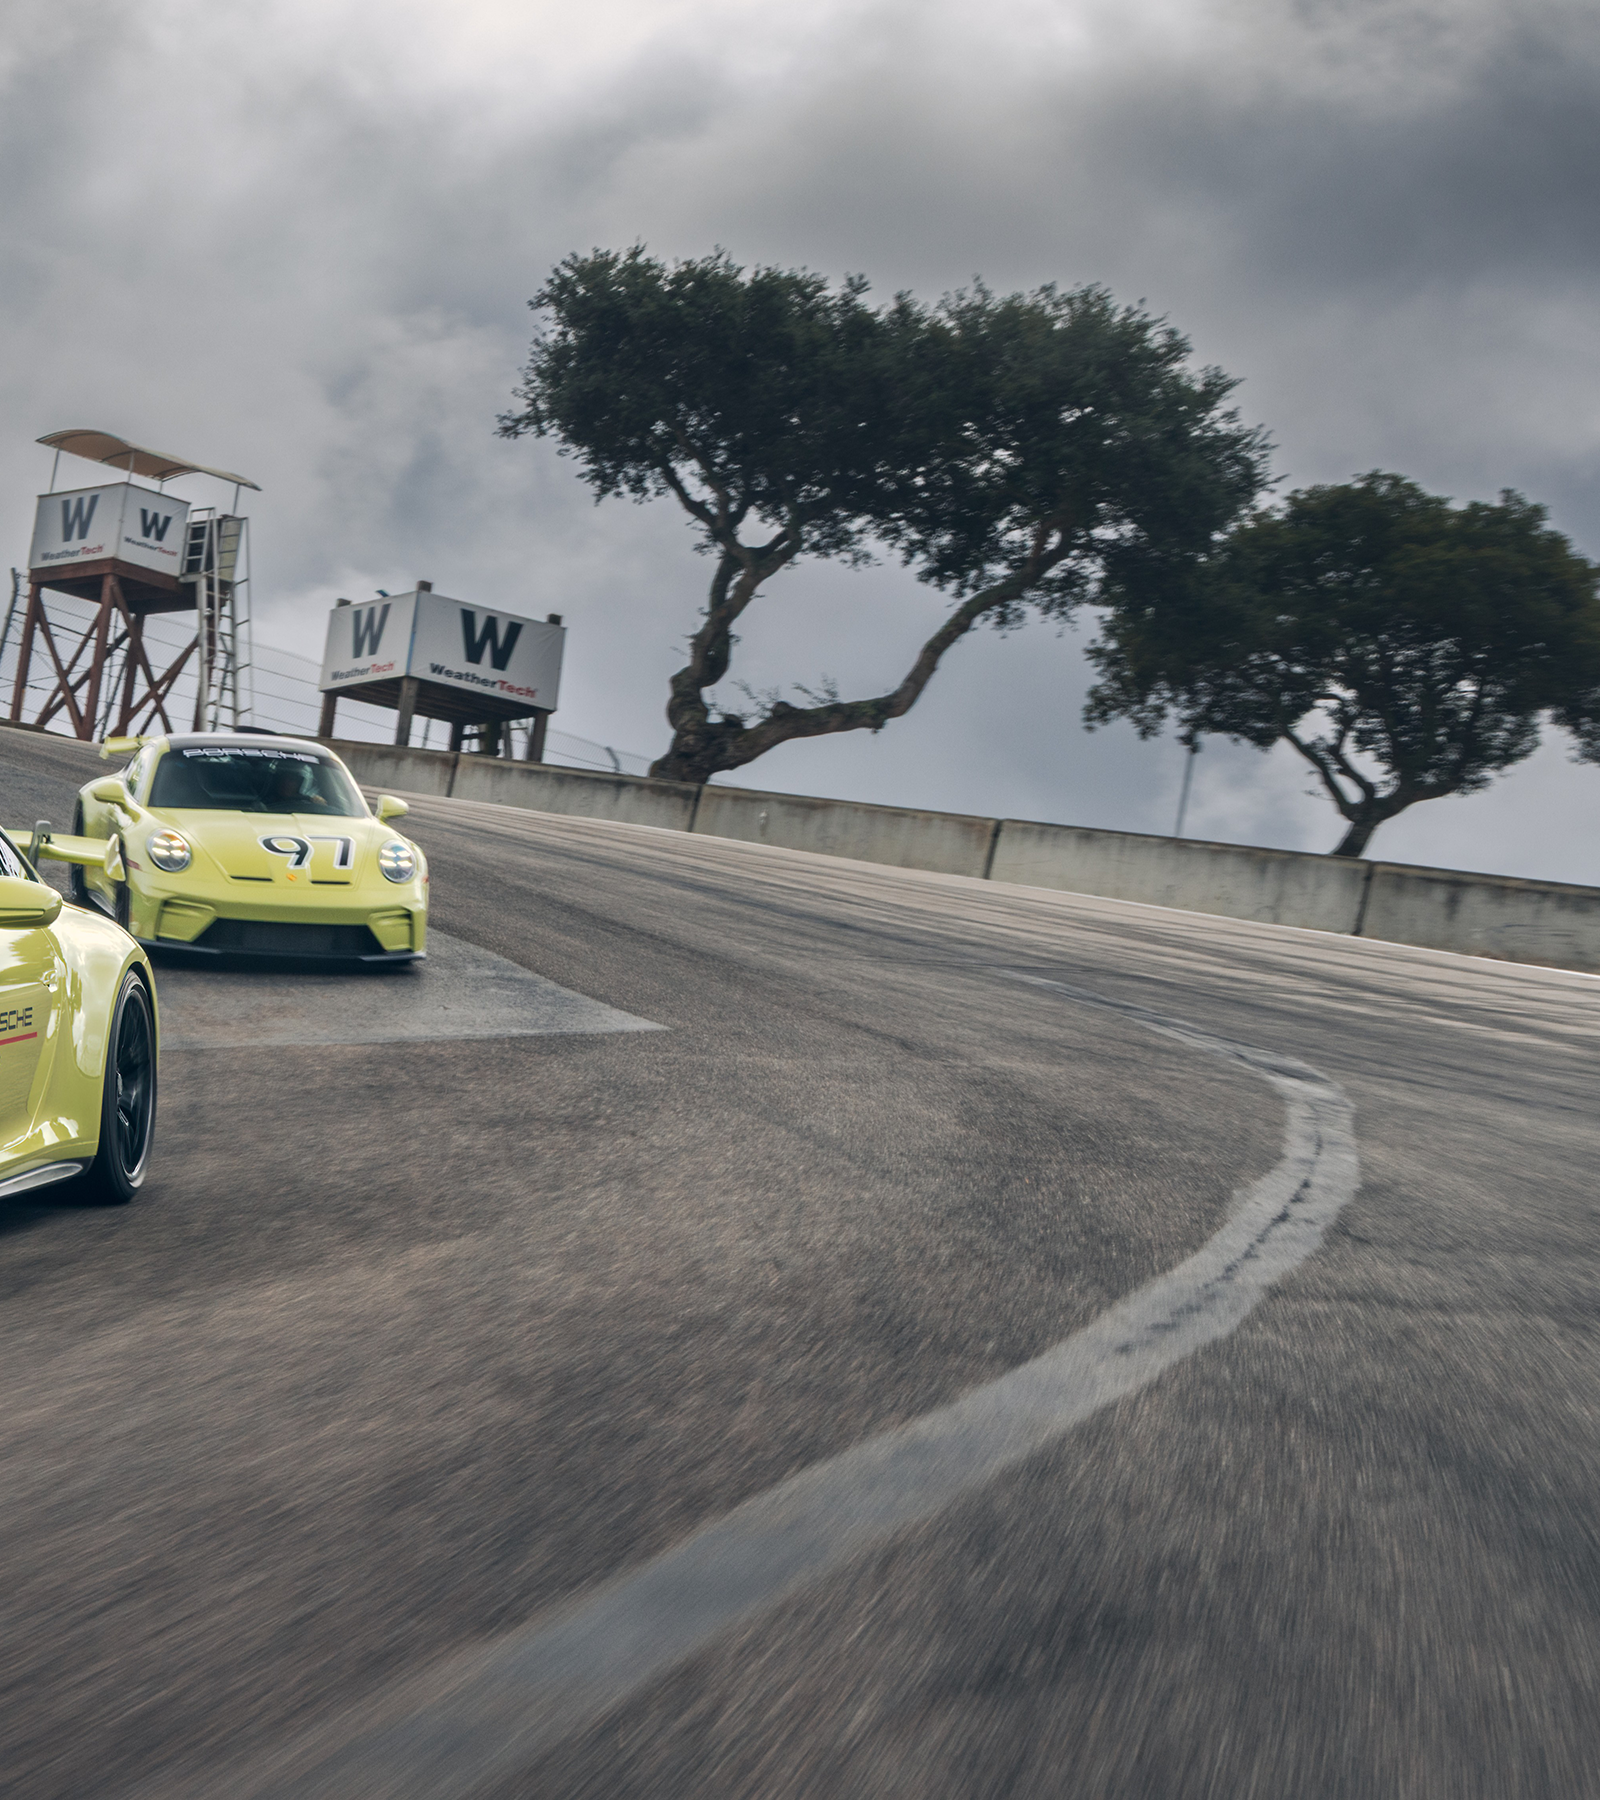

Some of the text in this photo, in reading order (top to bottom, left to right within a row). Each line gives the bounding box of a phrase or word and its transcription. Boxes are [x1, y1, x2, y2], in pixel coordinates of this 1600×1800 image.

[61, 493, 99, 542] W
[140, 507, 172, 542] W
[41, 544, 103, 561] WeatherTech
[352, 603, 392, 659] W
[460, 608, 524, 671] W
[331, 661, 395, 682] WeatherTech
[430, 662, 537, 698] WeatherTech
[258, 834, 357, 870] 97
